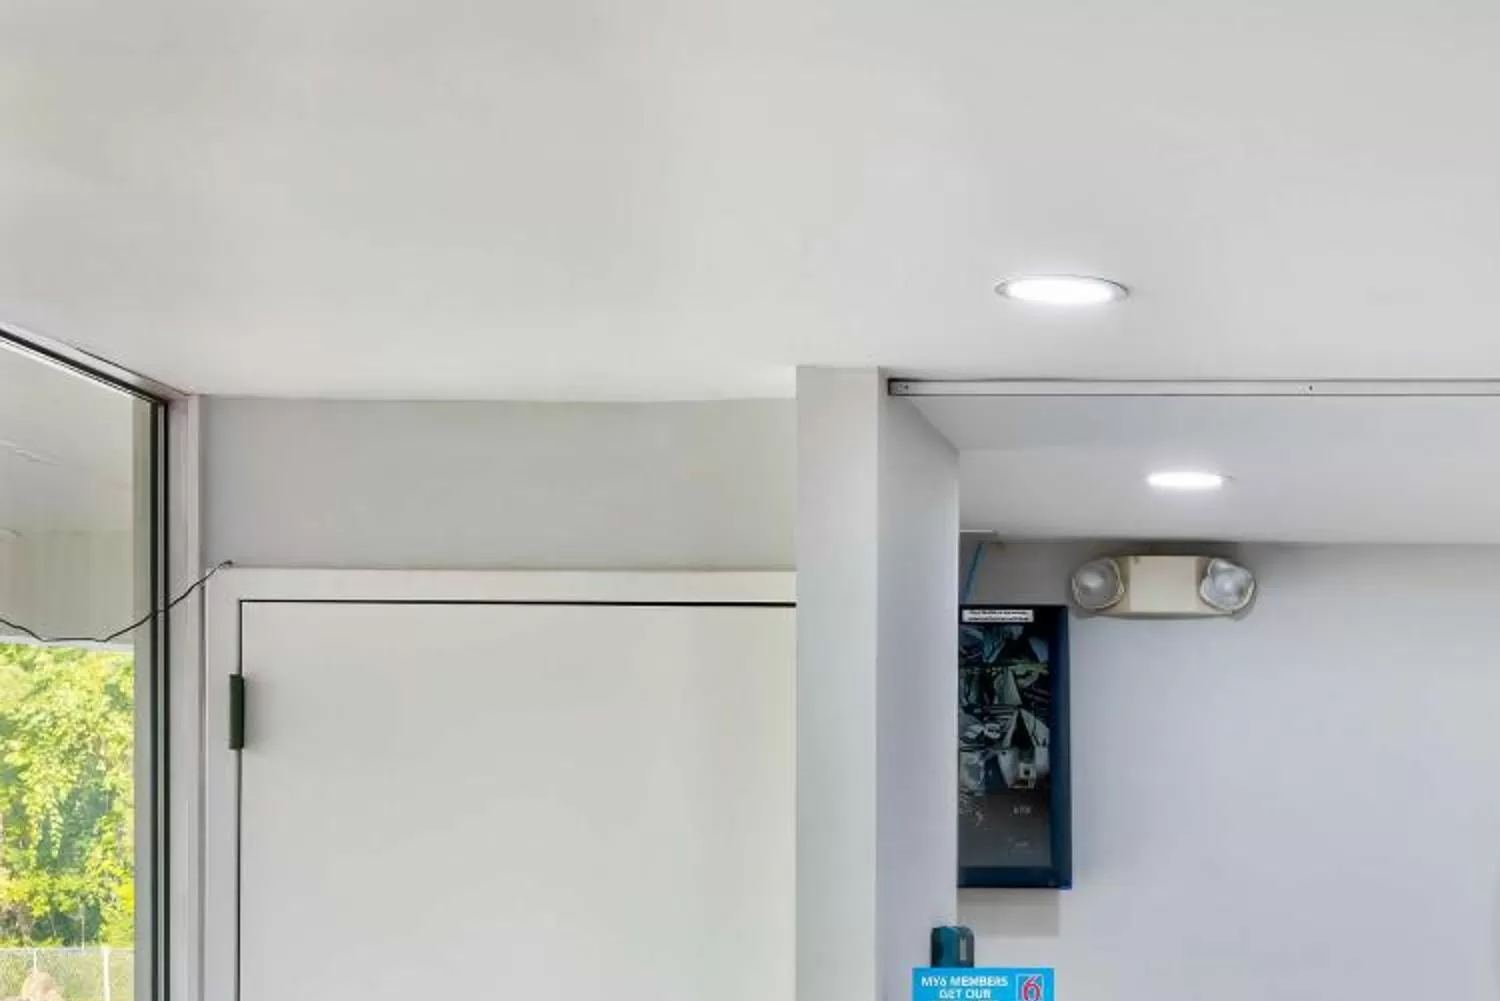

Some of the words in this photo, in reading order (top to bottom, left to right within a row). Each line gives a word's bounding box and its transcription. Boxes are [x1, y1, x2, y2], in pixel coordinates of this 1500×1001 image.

[921, 975, 947, 987] MY6
[949, 975, 1009, 987] MEMBERS
[939, 988, 961, 999] GET
[965, 988, 991, 999] OUR
